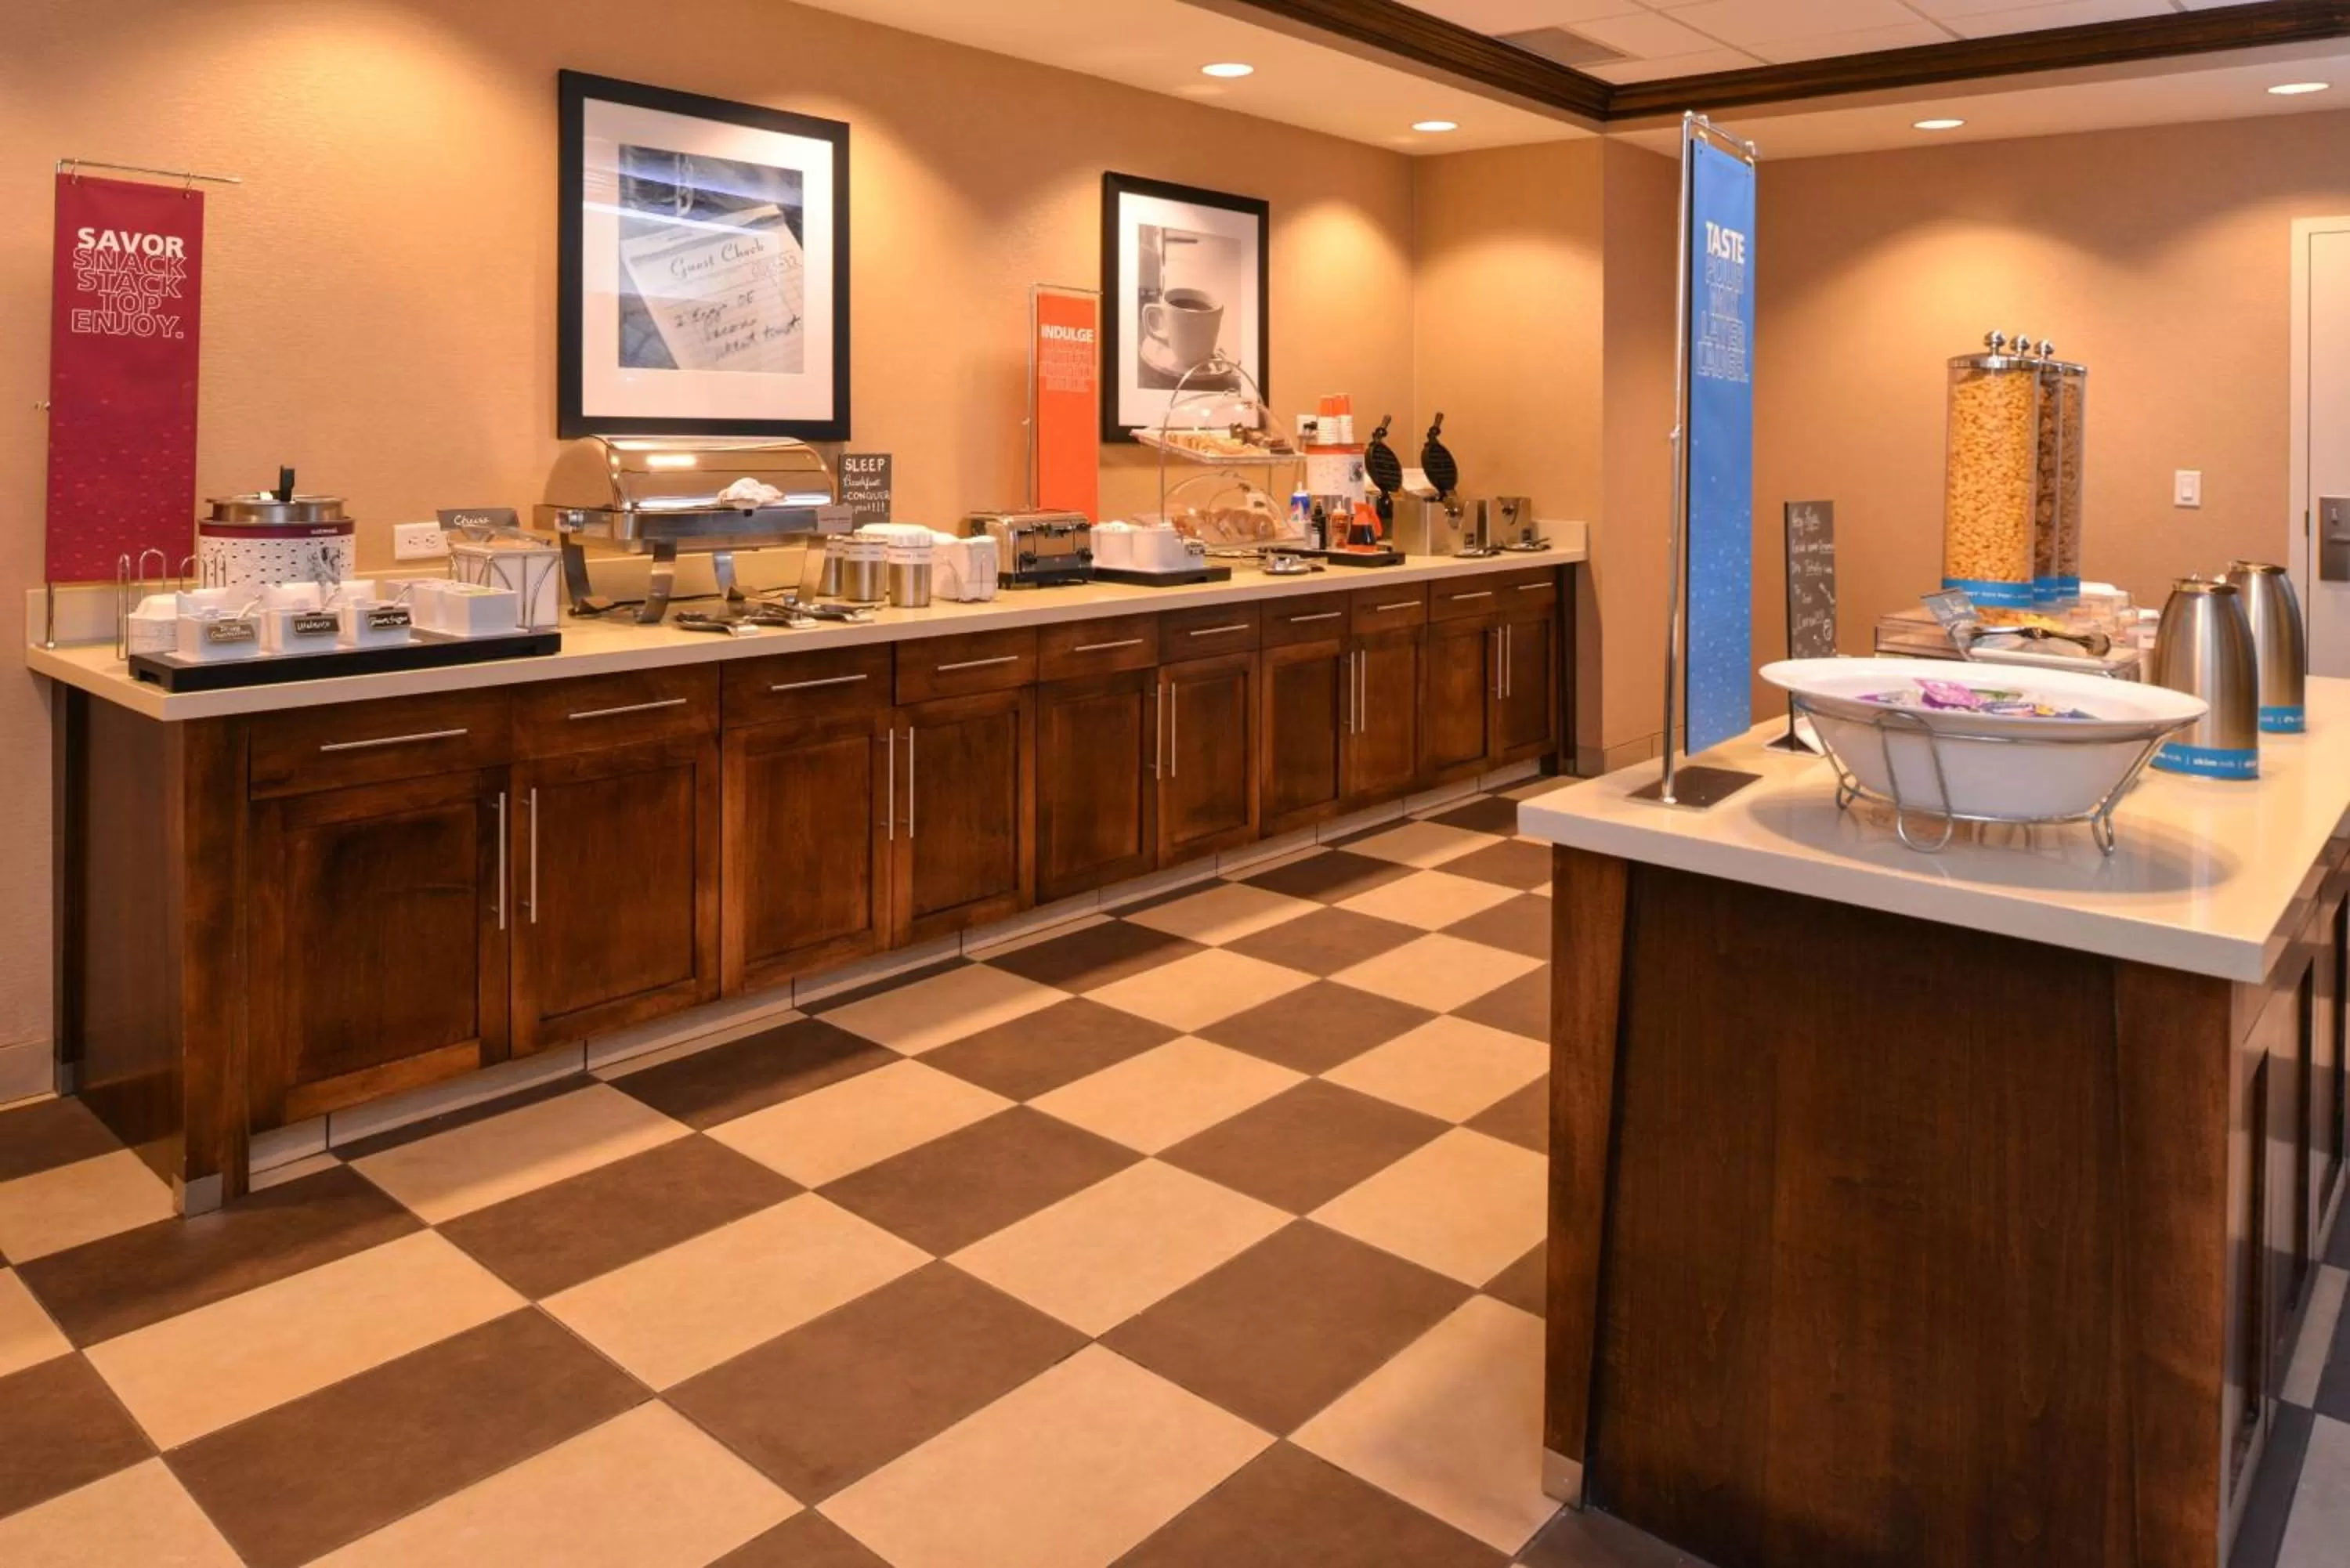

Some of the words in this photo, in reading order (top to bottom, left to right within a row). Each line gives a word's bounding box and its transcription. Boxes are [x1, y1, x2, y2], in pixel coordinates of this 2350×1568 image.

[77, 227, 184, 258] SAVOR
[1705, 221, 1746, 265] TASTE
[73, 247, 187, 279] SNACK
[671, 256, 714, 280] Guest
[721, 238, 765, 262] Check
[77, 268, 183, 298] STACK
[98, 291, 162, 316] TOP
[71, 309, 185, 338] ENJOY.
[1040, 324, 1094, 343] INDULGE
[845, 458, 884, 471] SLEEP
